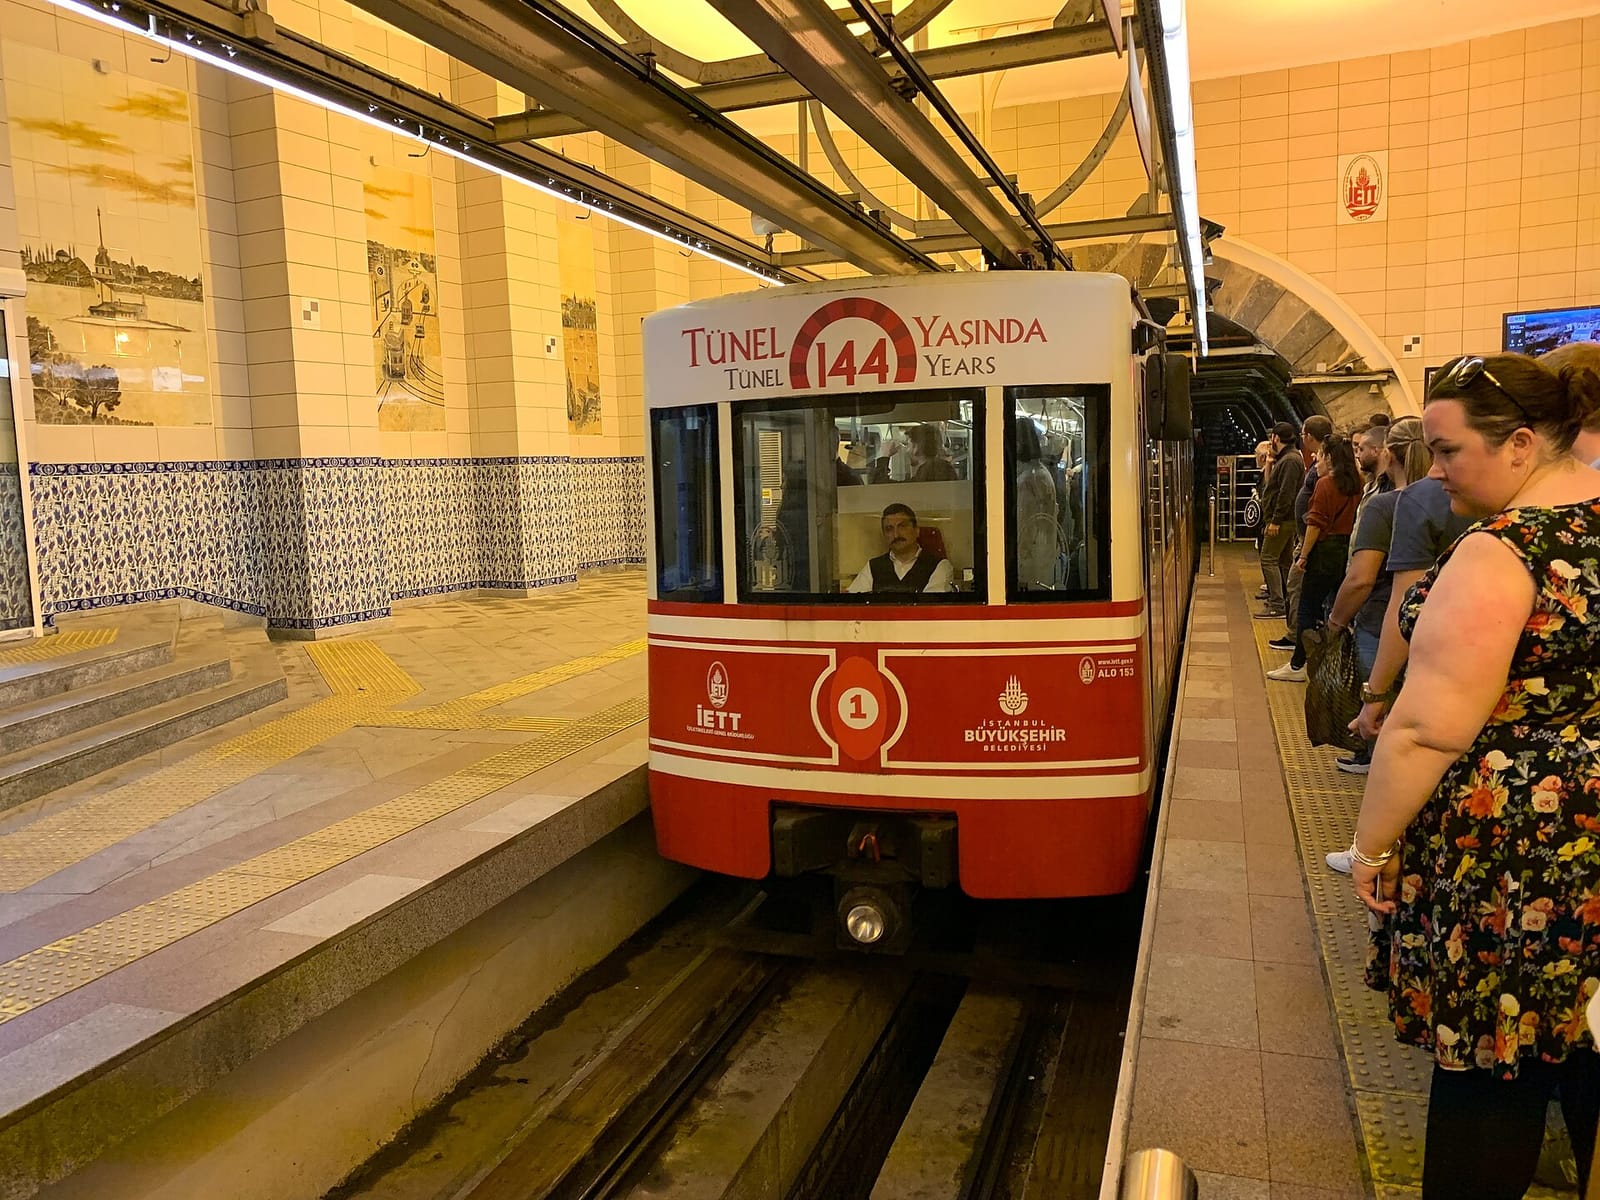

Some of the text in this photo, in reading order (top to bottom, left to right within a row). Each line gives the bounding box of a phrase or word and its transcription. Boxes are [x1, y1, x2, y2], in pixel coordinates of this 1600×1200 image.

[681, 315, 1048, 367] TÜNEL YAŞINDA
[724, 354, 996, 390] TÜNEL YEARS
[816, 338, 889, 388] 144
[1097, 668, 1134, 678] ALO 153
[849, 694, 867, 719] 1
[964, 725, 1067, 745] BÜYÜKŞEHİR
